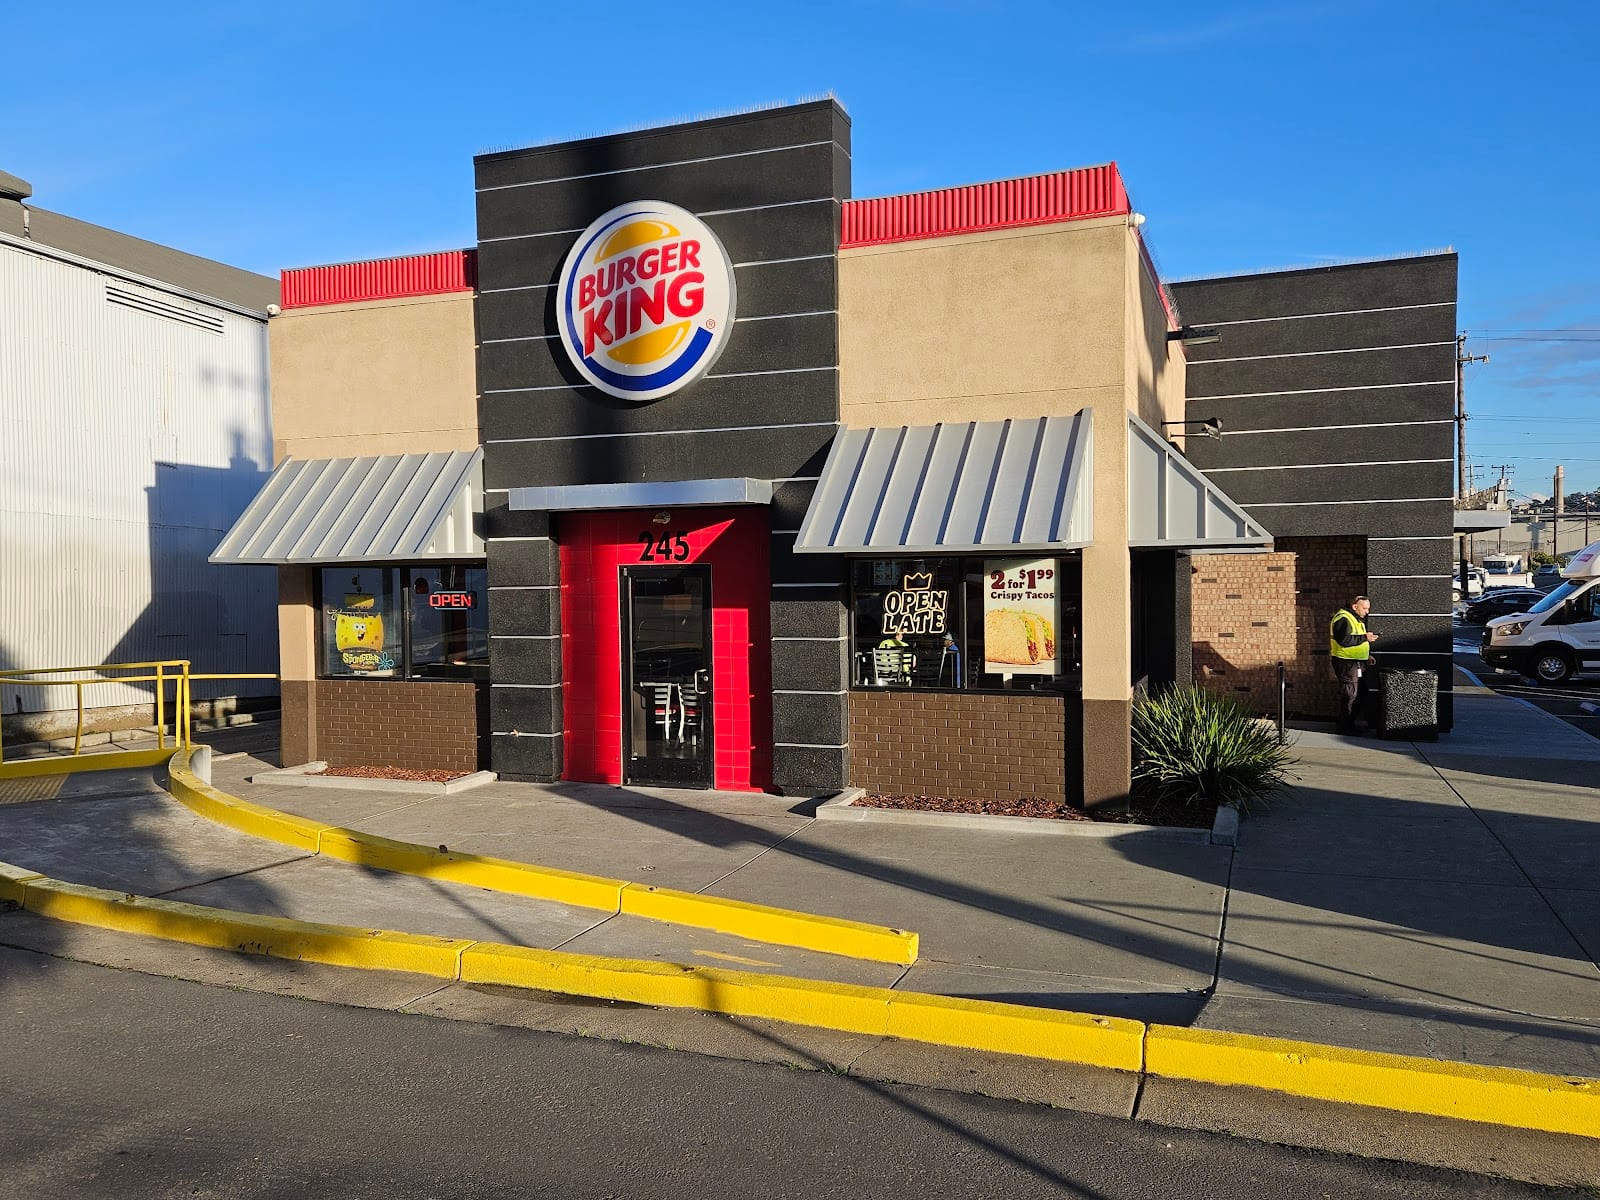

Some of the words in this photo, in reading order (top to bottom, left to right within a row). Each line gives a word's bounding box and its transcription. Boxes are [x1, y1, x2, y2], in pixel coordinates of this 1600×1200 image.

[579, 239, 701, 312] BURGER
[584, 271, 705, 358] KING
[638, 530, 690, 562] 245
[990, 569, 1006, 590] 2
[1007, 579, 1025, 589] for
[429, 593, 472, 608] OPEN
[884, 590, 948, 616] OPEN
[990, 591, 1024, 602] Crispy
[1025, 591, 1056, 600] Tacos
[882, 609, 946, 634] LATE
